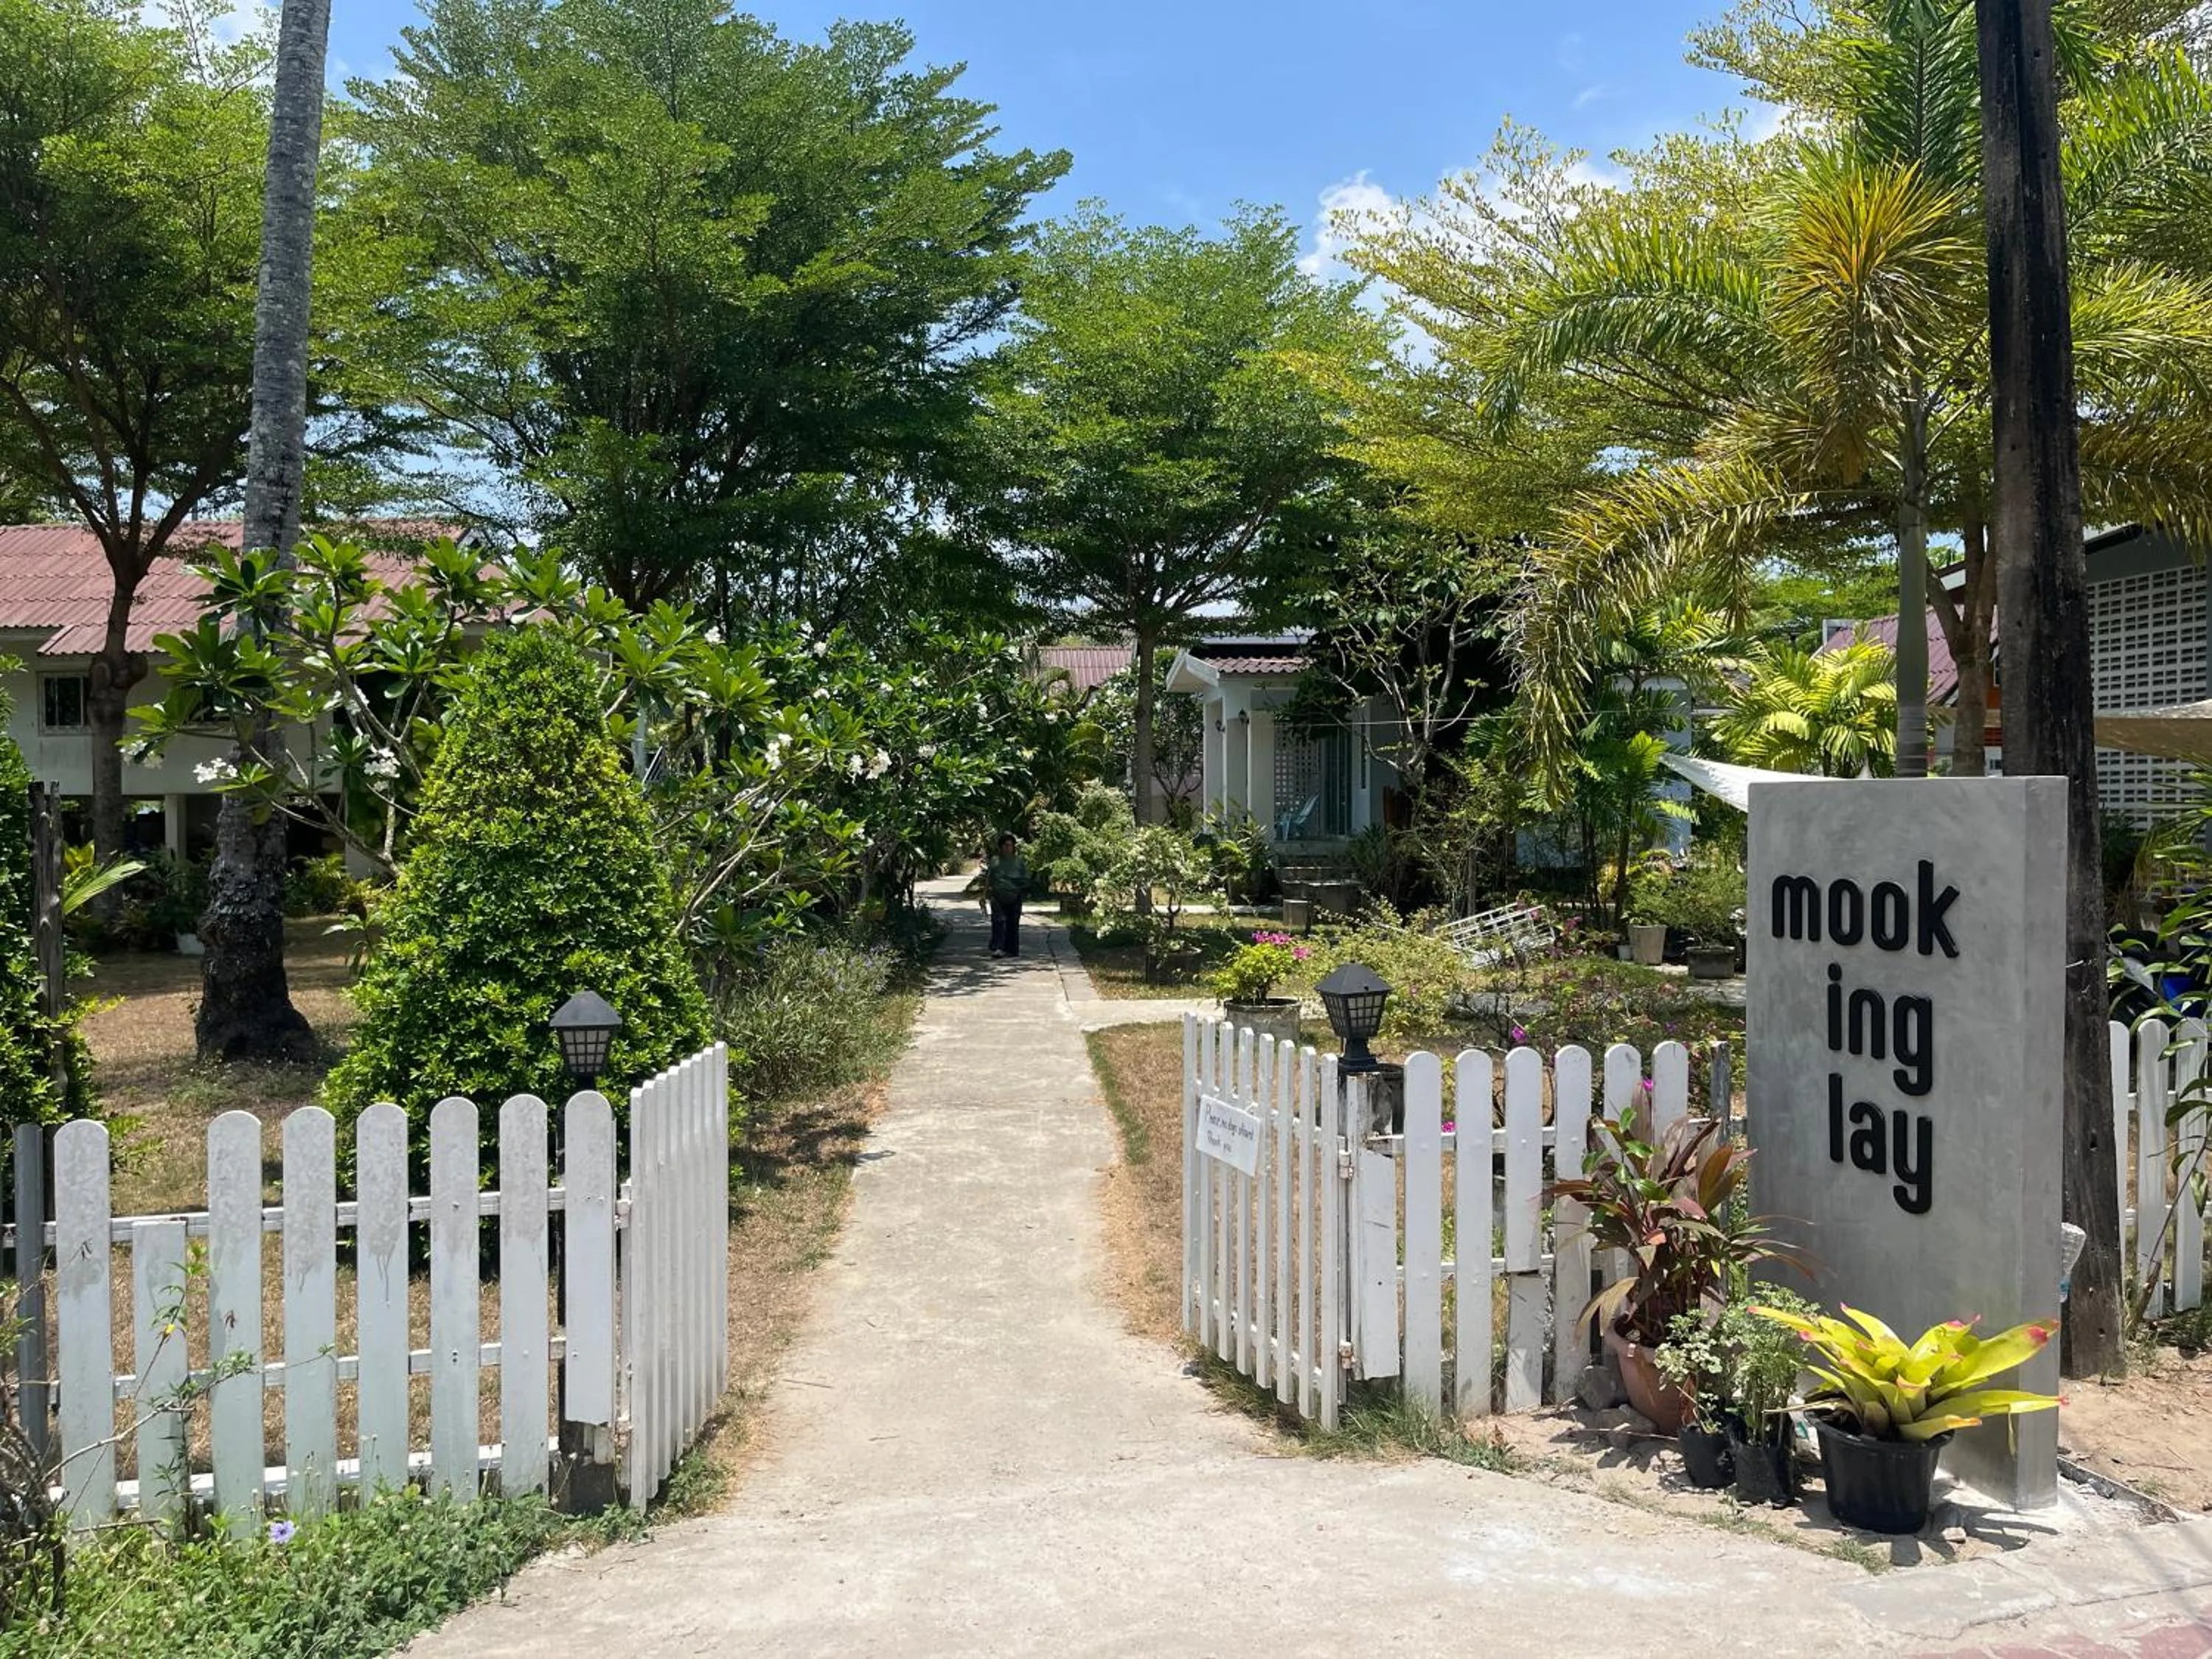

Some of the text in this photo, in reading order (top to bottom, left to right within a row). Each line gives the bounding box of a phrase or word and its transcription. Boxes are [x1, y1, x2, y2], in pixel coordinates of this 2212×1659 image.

[1771, 859, 1961, 960] mook
[1826, 962, 1933, 1097] ing
[1828, 1072, 1933, 1216] lay
